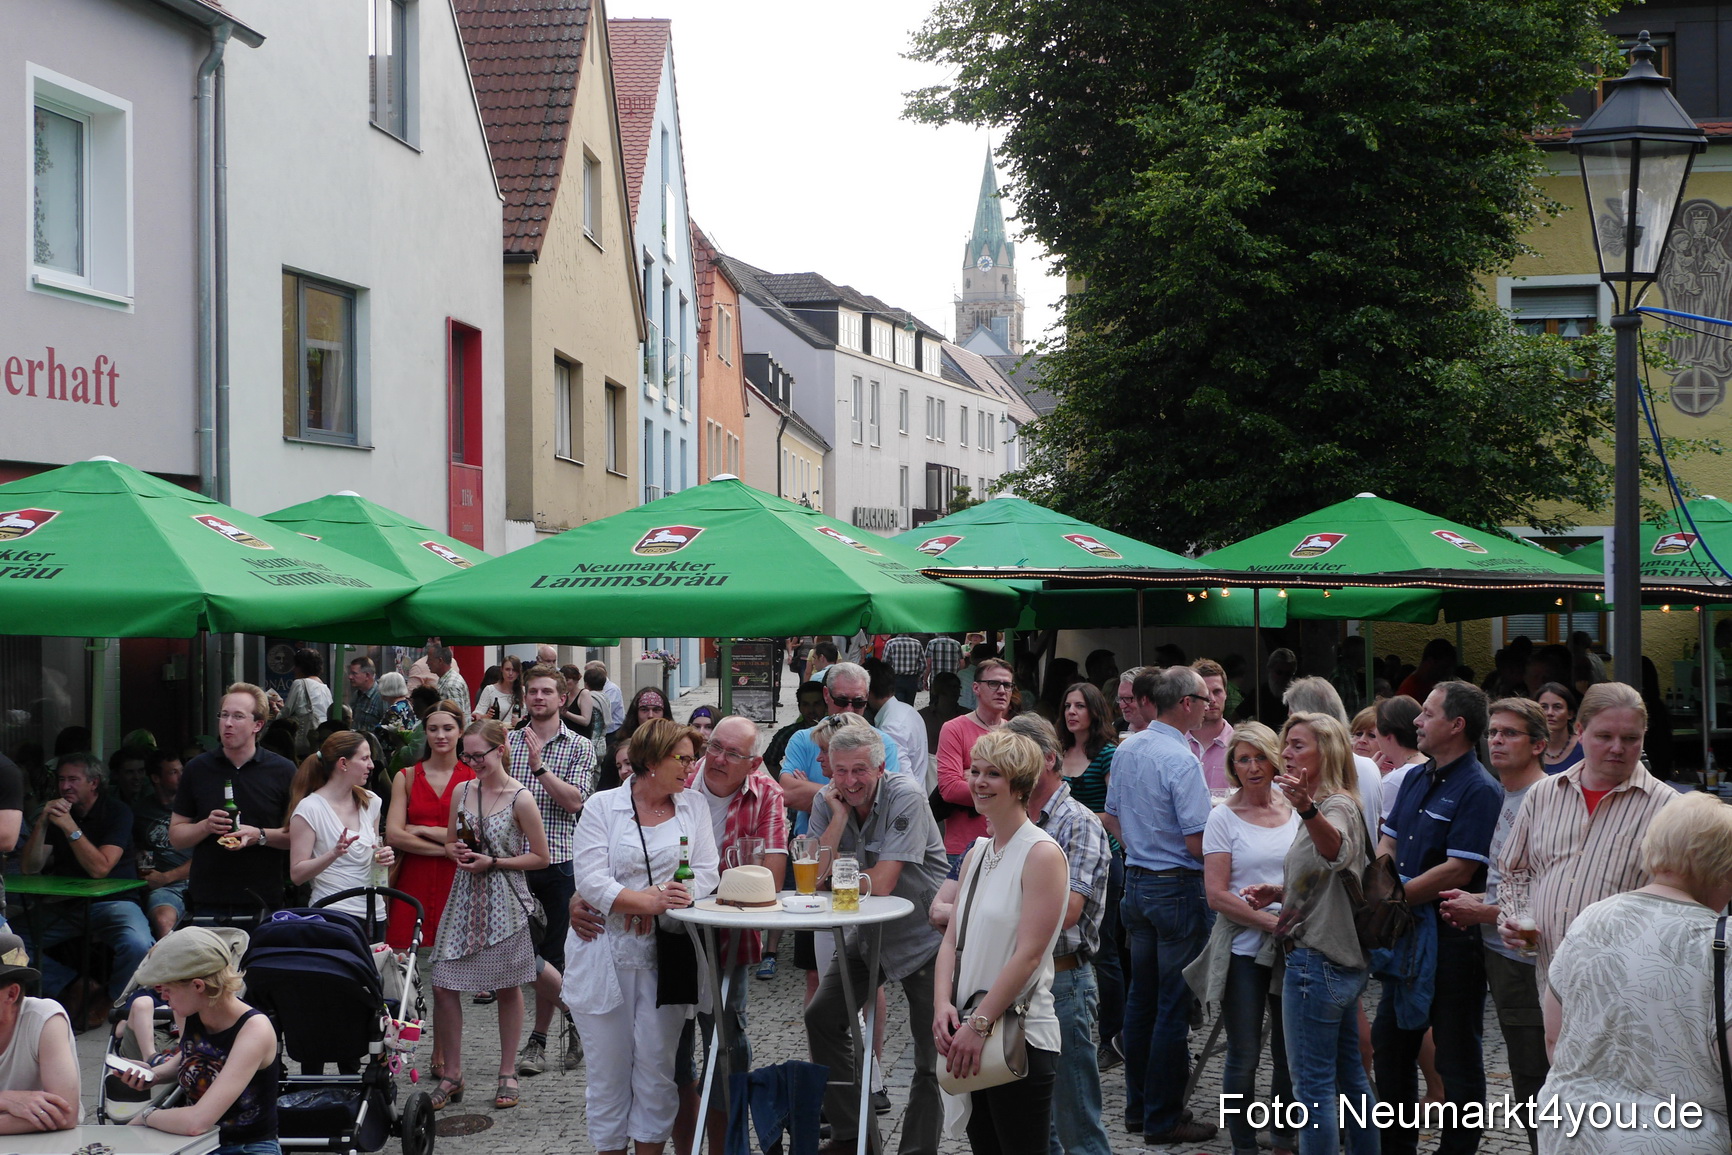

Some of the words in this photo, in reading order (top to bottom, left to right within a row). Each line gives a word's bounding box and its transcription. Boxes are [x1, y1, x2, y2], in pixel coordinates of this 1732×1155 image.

[0, 346, 120, 408] erhaft
[854, 507, 898, 529] HACKNER
[0, 549, 56, 562] kter
[571, 560, 716, 574] Neumarkter
[1246, 562, 1347, 572] Neumarkter
[530, 572, 730, 589] Lammsbräu
